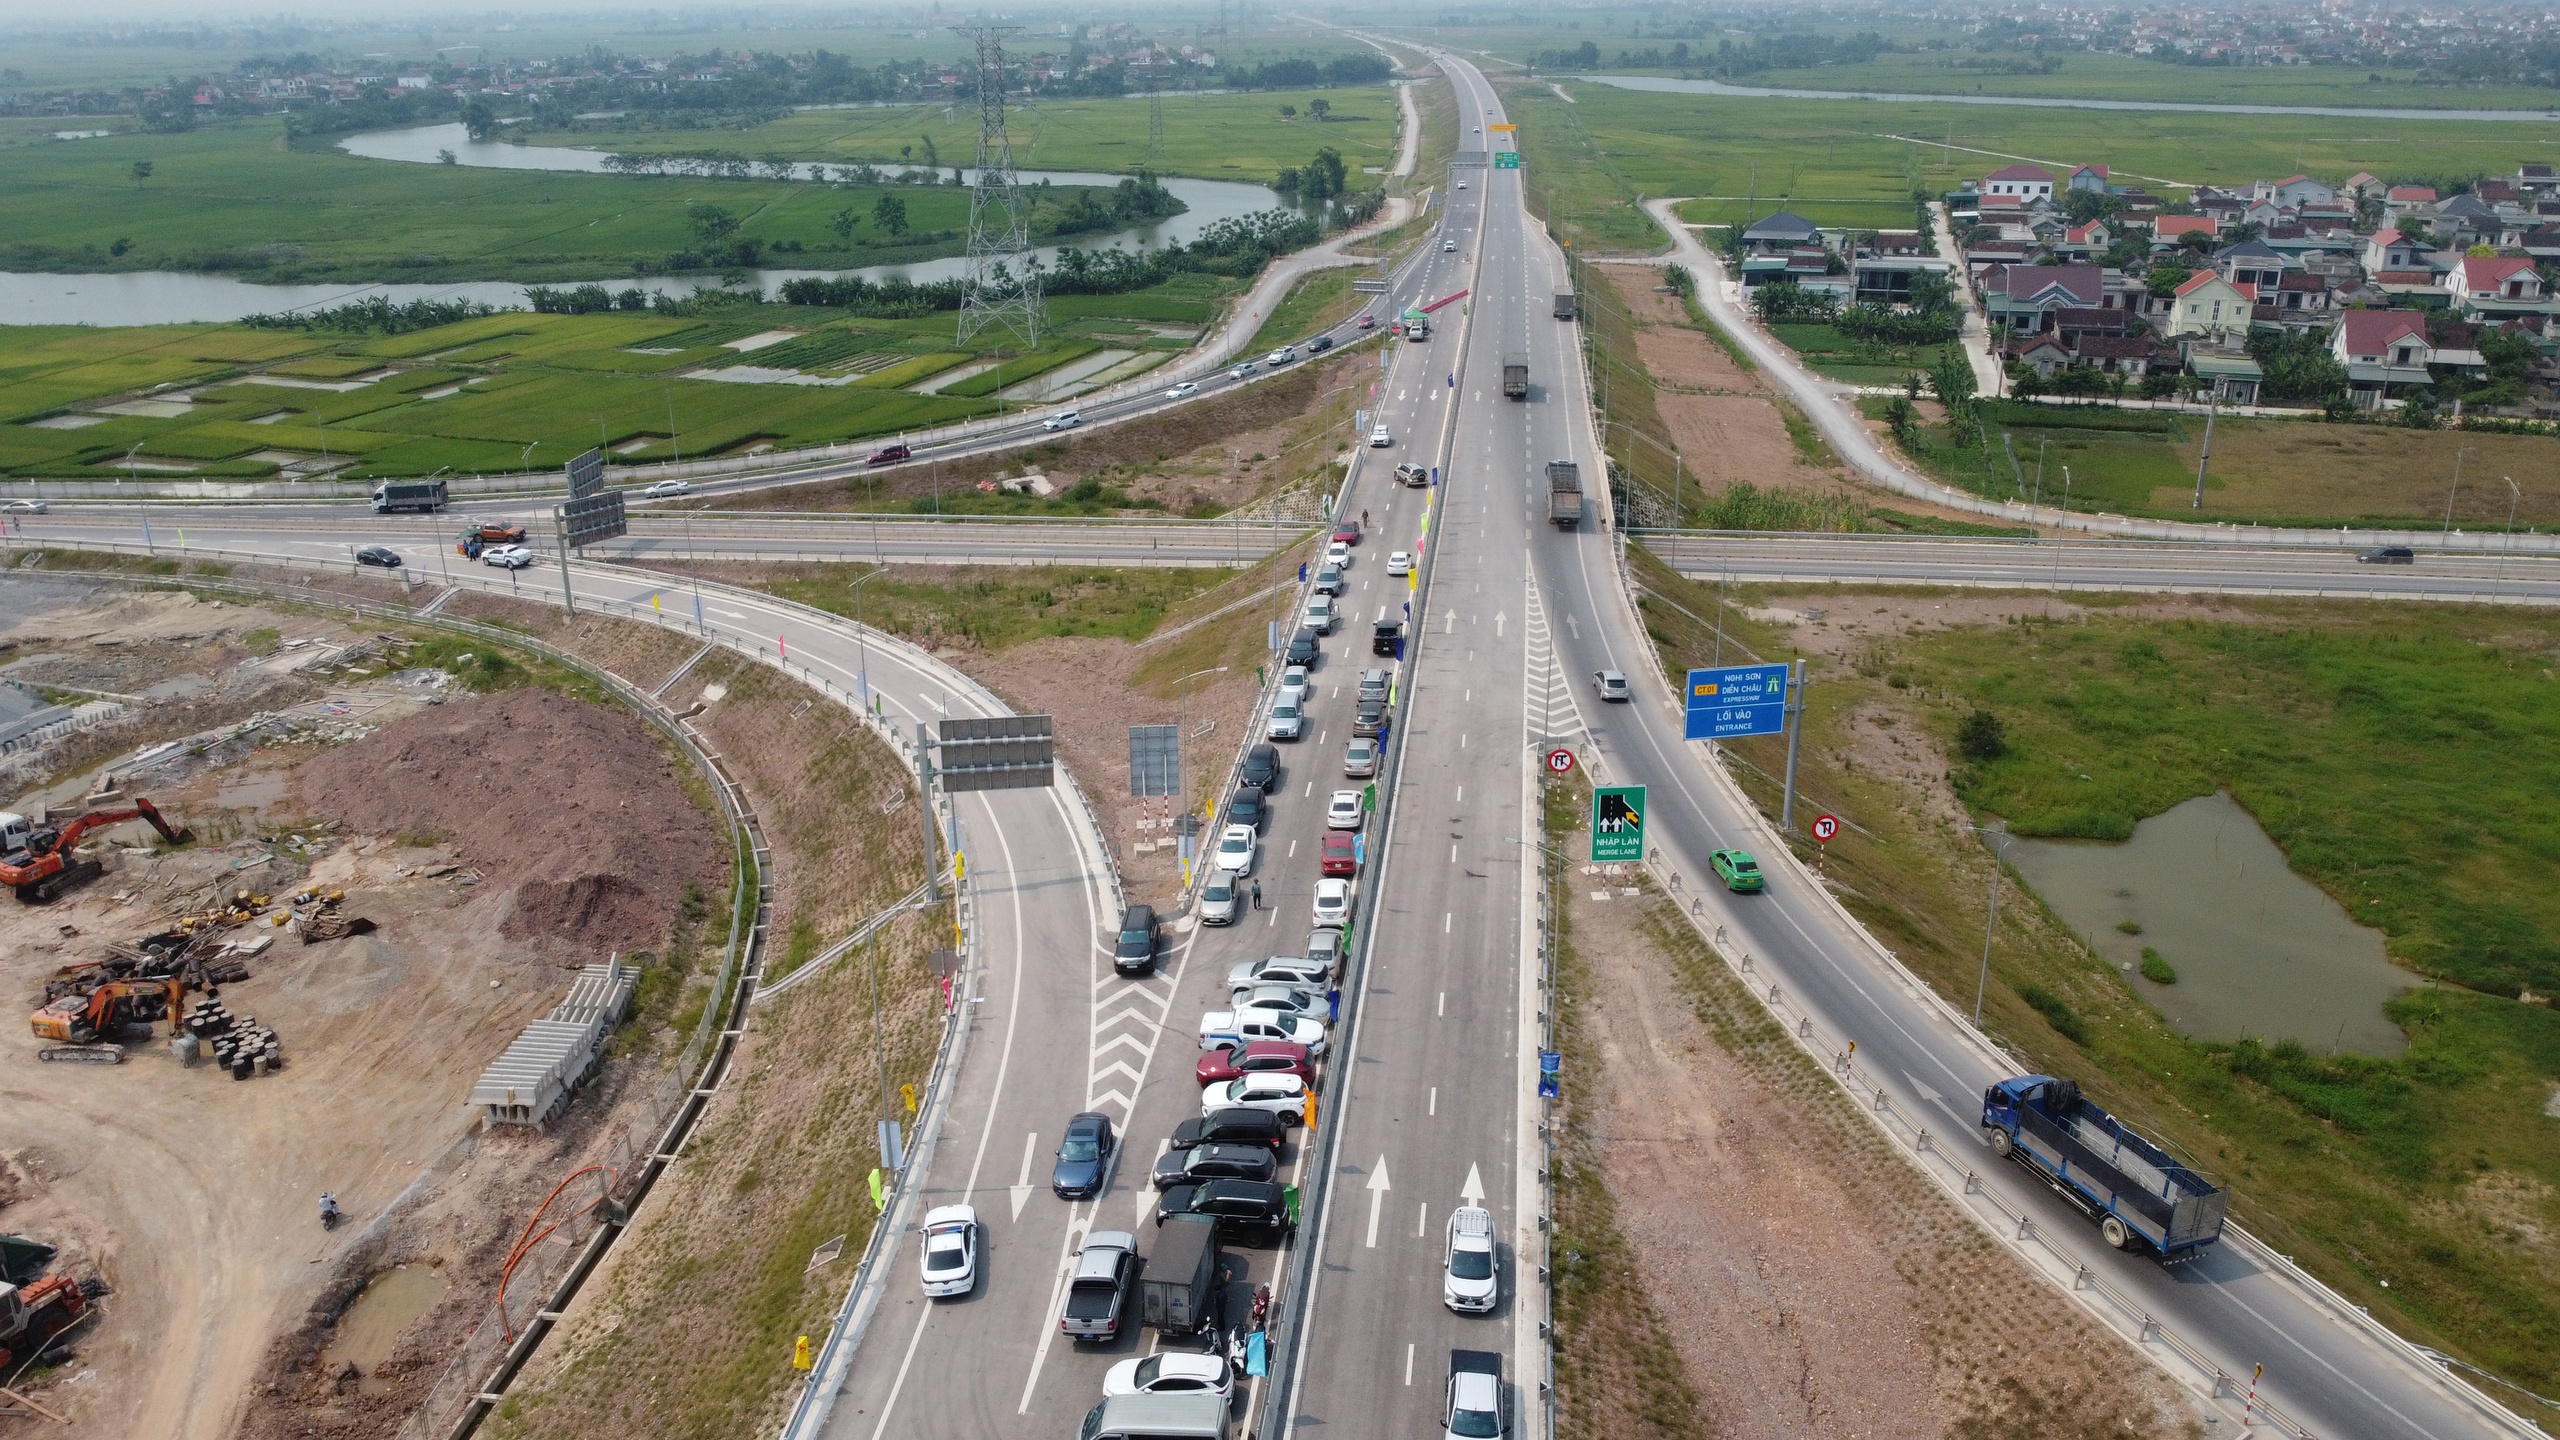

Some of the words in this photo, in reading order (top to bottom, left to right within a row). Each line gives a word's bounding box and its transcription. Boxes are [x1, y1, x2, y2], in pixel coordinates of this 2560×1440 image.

[1745, 672, 1761, 680] SƠN
[1742, 684, 1762, 692] CHÂU
[1723, 695, 1760, 703] EXPRESSWAY
[1716, 709, 1732, 721] LỐI
[1735, 708, 1752, 719] VÀO
[1716, 723, 1752, 732] ENTRANCE
[1596, 836, 1620, 848] NHẬP
[1622, 836, 1640, 846] LÀN
